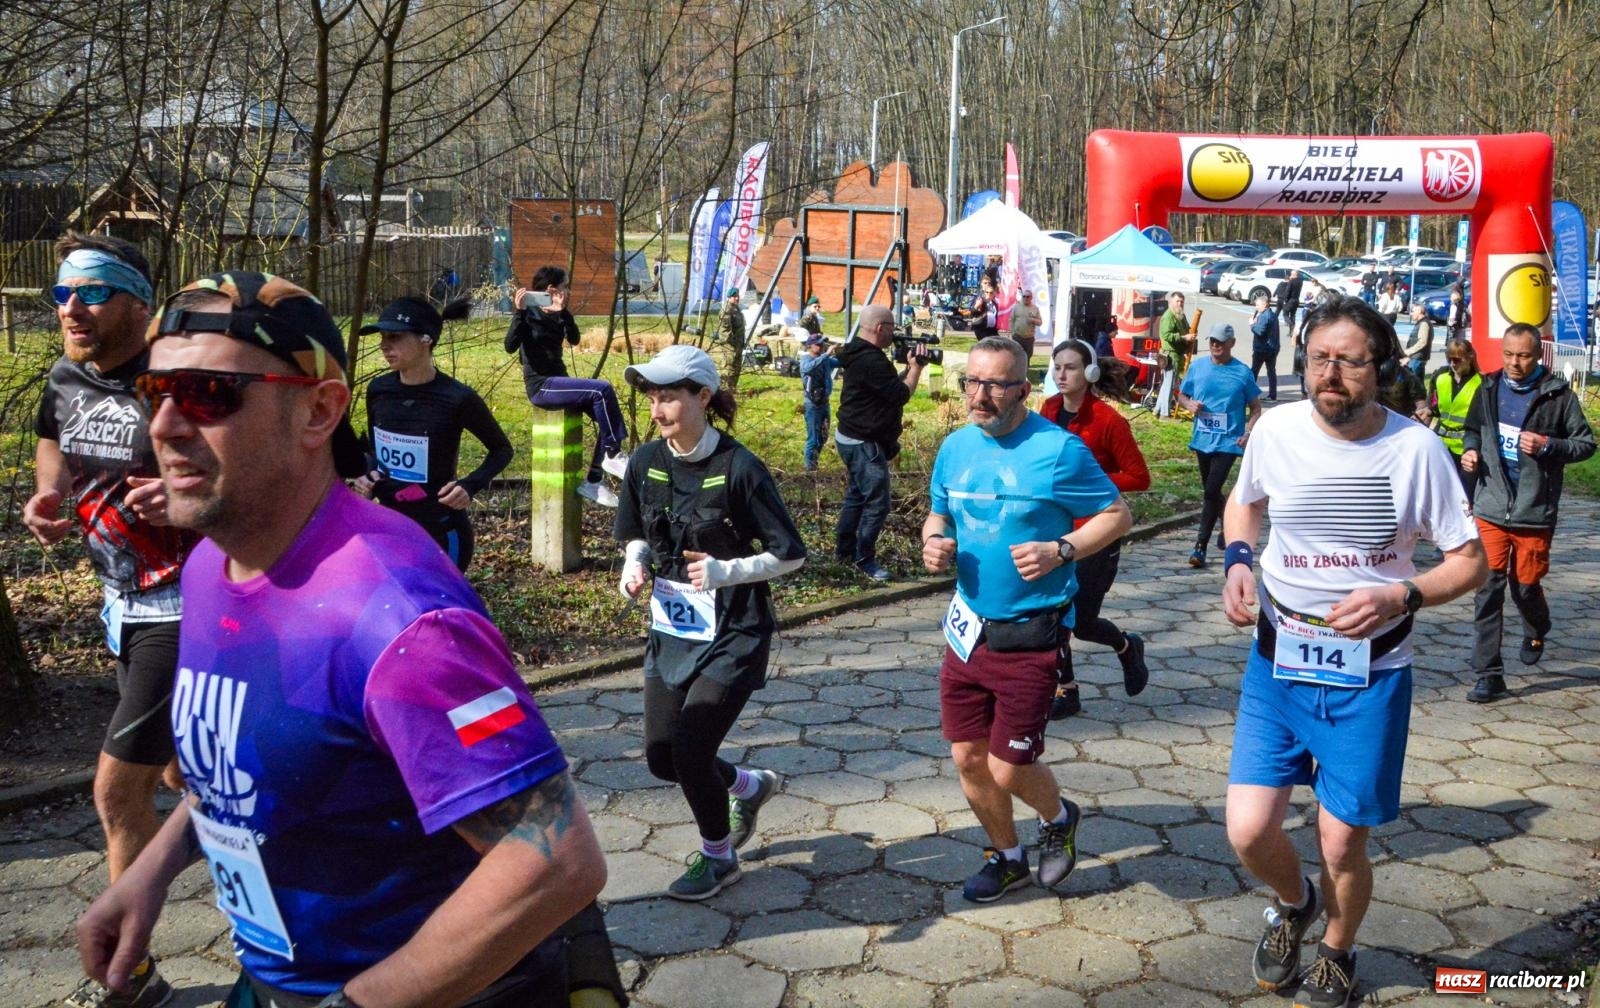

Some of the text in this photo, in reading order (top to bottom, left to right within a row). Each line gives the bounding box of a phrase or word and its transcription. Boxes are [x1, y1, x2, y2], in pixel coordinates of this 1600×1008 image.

[1308, 145, 1359, 158] BIEG
[1266, 164, 1404, 182] TWARDZIELA
[1277, 187, 1388, 204] RACIBÓRZ
[734, 155, 761, 268] RACIBÓRZ
[87, 421, 138, 446] SZCZYT
[1203, 419, 1221, 428] 128
[1498, 434, 1518, 449] 05
[381, 446, 416, 469] 050
[1283, 551, 1398, 569] BIEG ZBÓJA TEAM
[664, 600, 696, 624] 121
[1298, 643, 1346, 669] 114
[216, 861, 255, 916] 91
